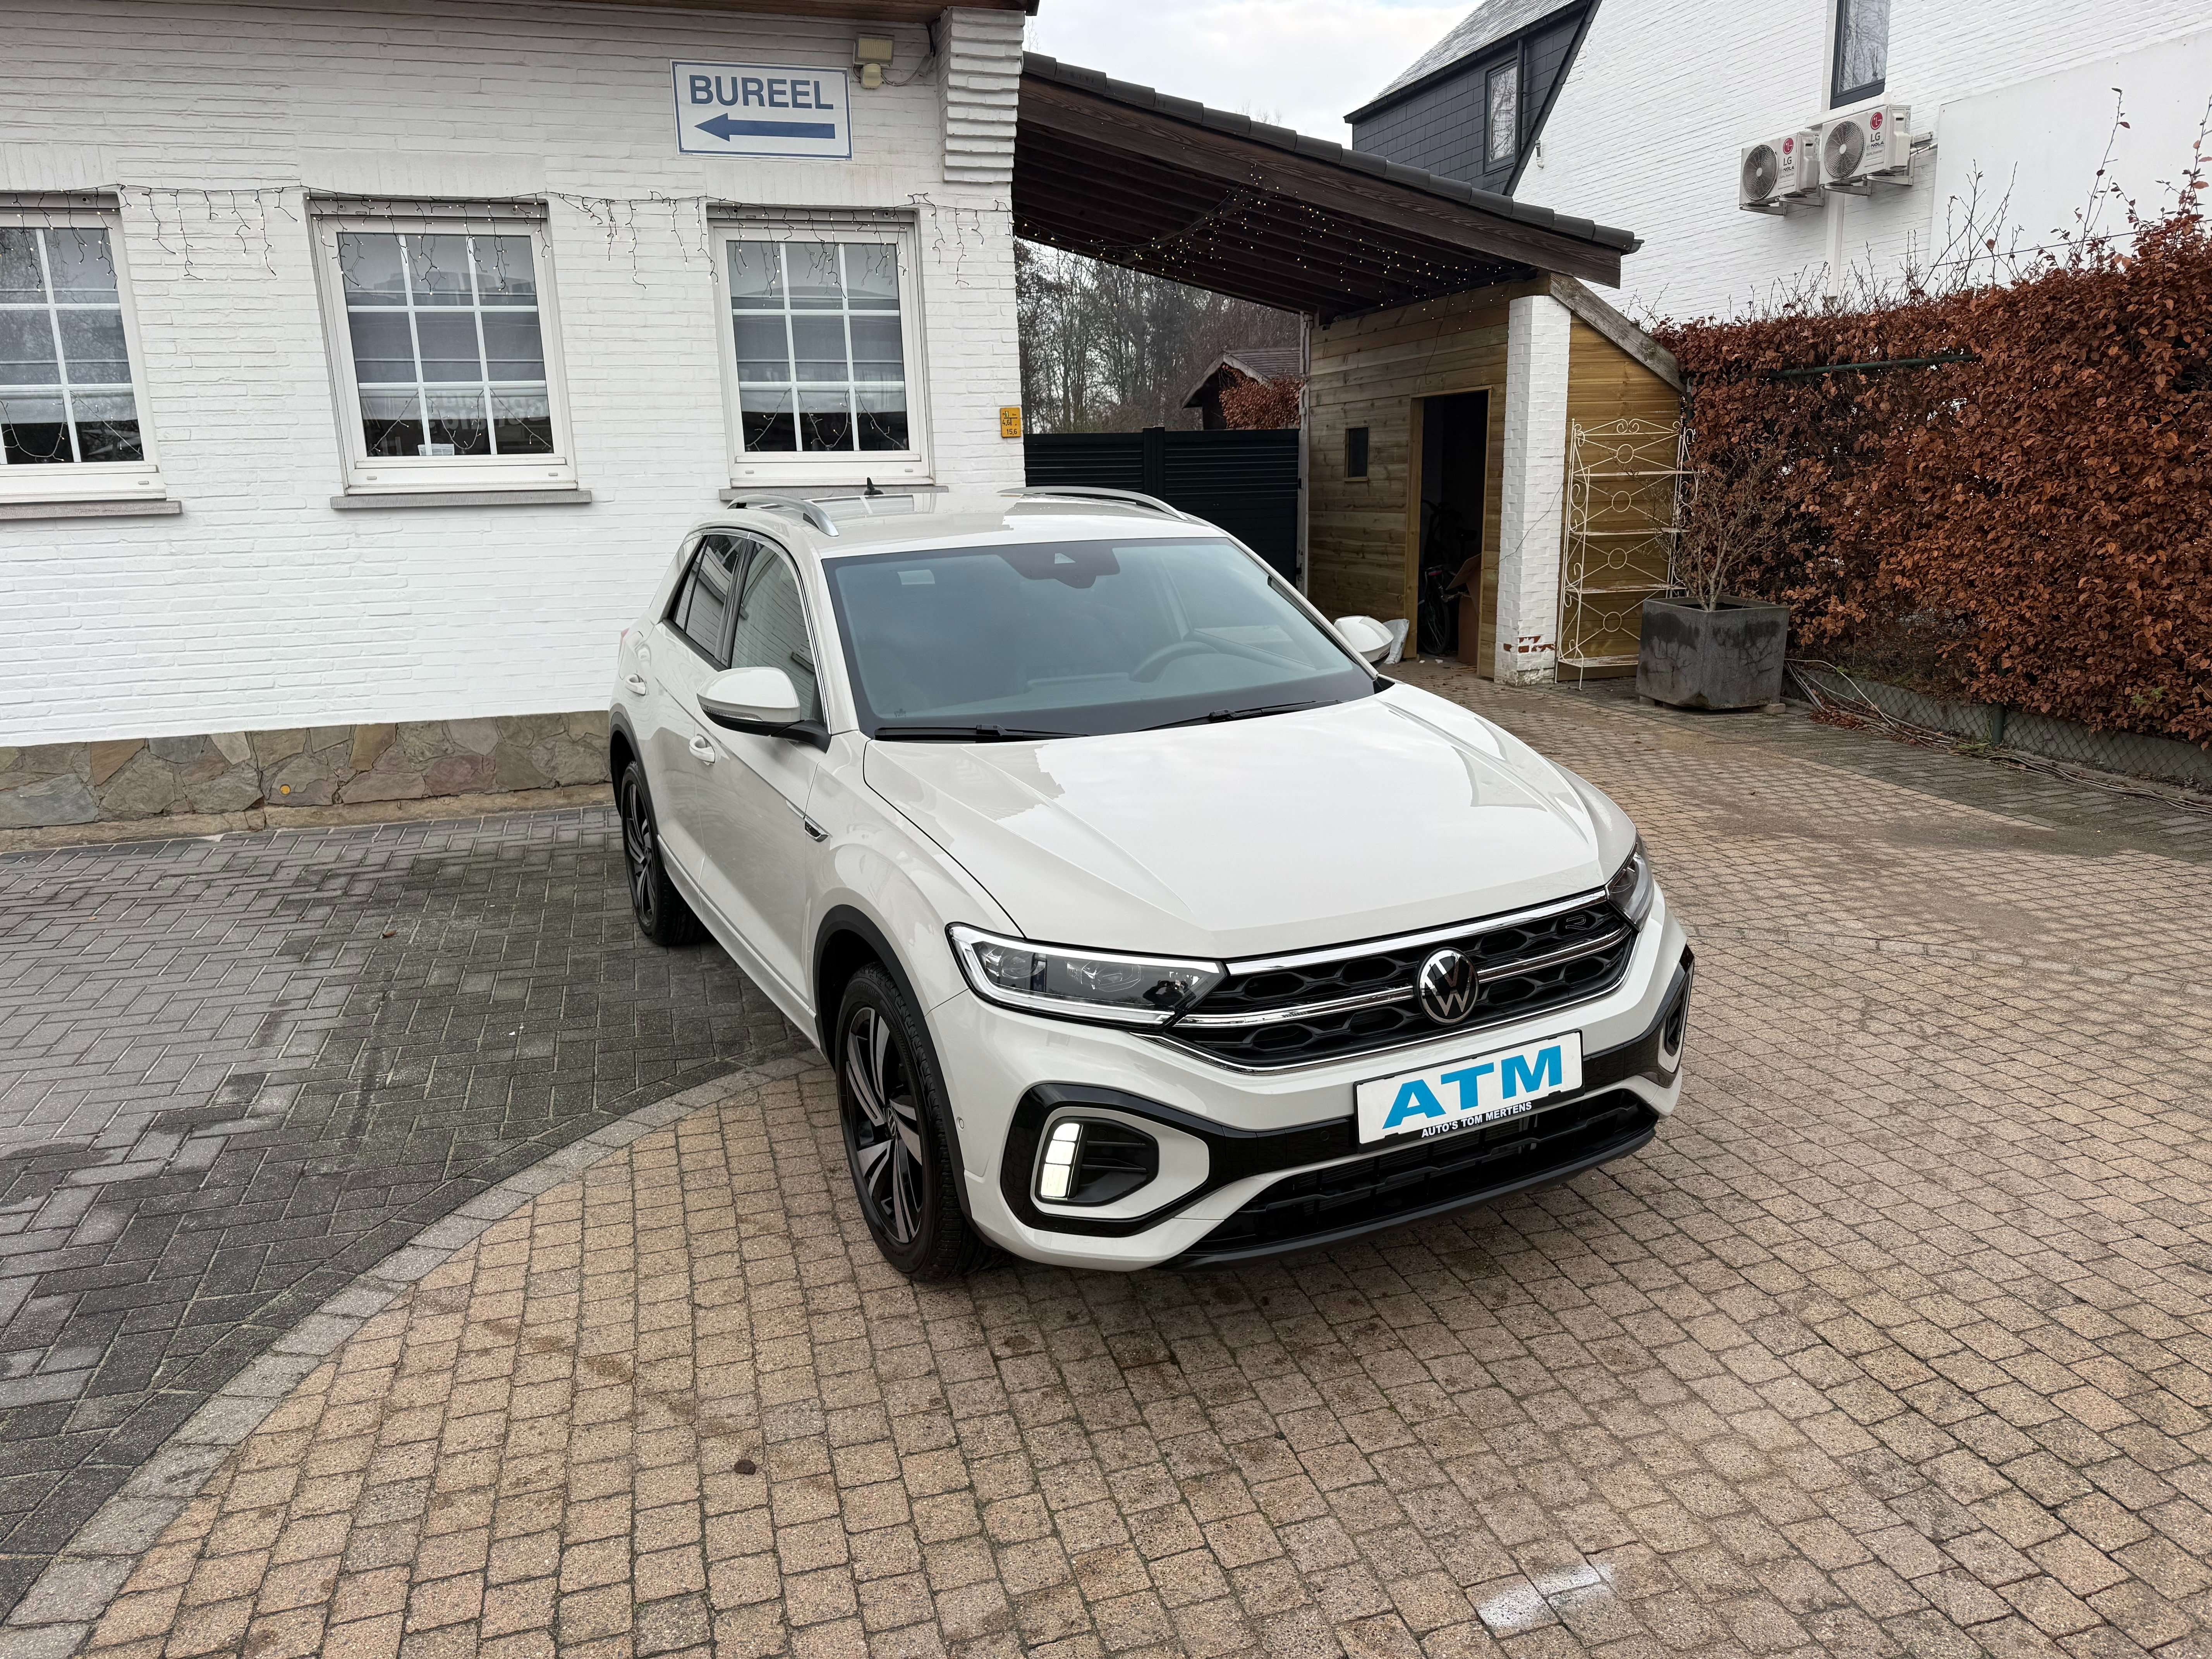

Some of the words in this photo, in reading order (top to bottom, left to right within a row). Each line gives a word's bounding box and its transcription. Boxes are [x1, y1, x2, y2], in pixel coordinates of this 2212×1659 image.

[689, 75, 834, 110] BUREEL
[1870, 132, 1881, 142] LG
[1783, 156, 1792, 166] LG
[1420, 950, 1477, 1023] VW
[1382, 1045, 1562, 1130] ATM
[1421, 1121, 1458, 1138] AUTO'S
[1461, 1115, 1483, 1128] TOM
[1486, 1101, 1532, 1121] MERTENS
